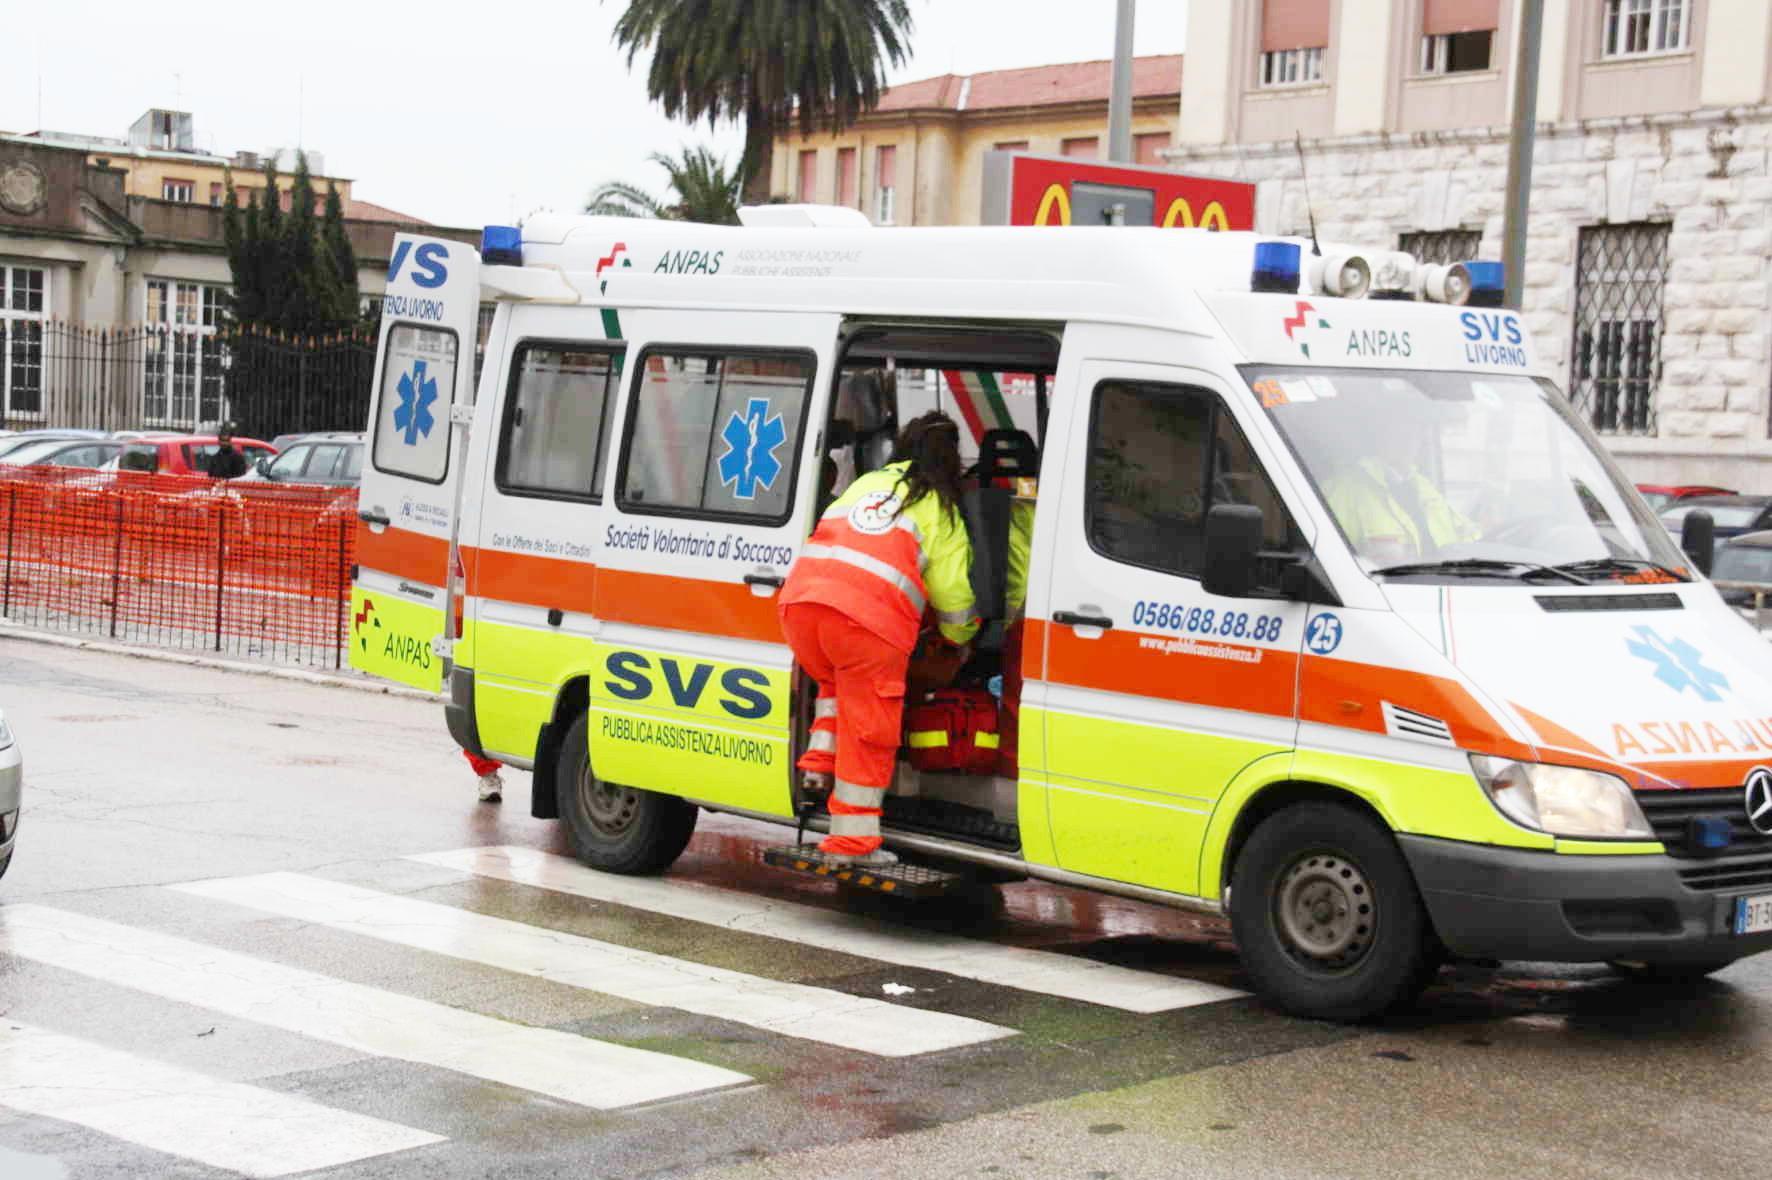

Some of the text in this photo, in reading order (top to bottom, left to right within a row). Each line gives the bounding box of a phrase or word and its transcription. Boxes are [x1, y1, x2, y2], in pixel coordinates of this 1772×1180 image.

[654, 250, 724, 275] ANPAS
[1346, 329, 1412, 357] ANPAS
[1460, 312, 1522, 344] SVS
[1465, 343, 1526, 367] LIVORNO
[605, 524, 792, 565] Società Volontaria di Soccorso
[1132, 600, 1282, 642] 0586/88.88.88
[1309, 614, 1338, 651] 25
[384, 632, 432, 669] ANPAS
[604, 651, 773, 719] SVS
[602, 716, 773, 766] PUBBLICA ASSISTENZA LIVORNO
